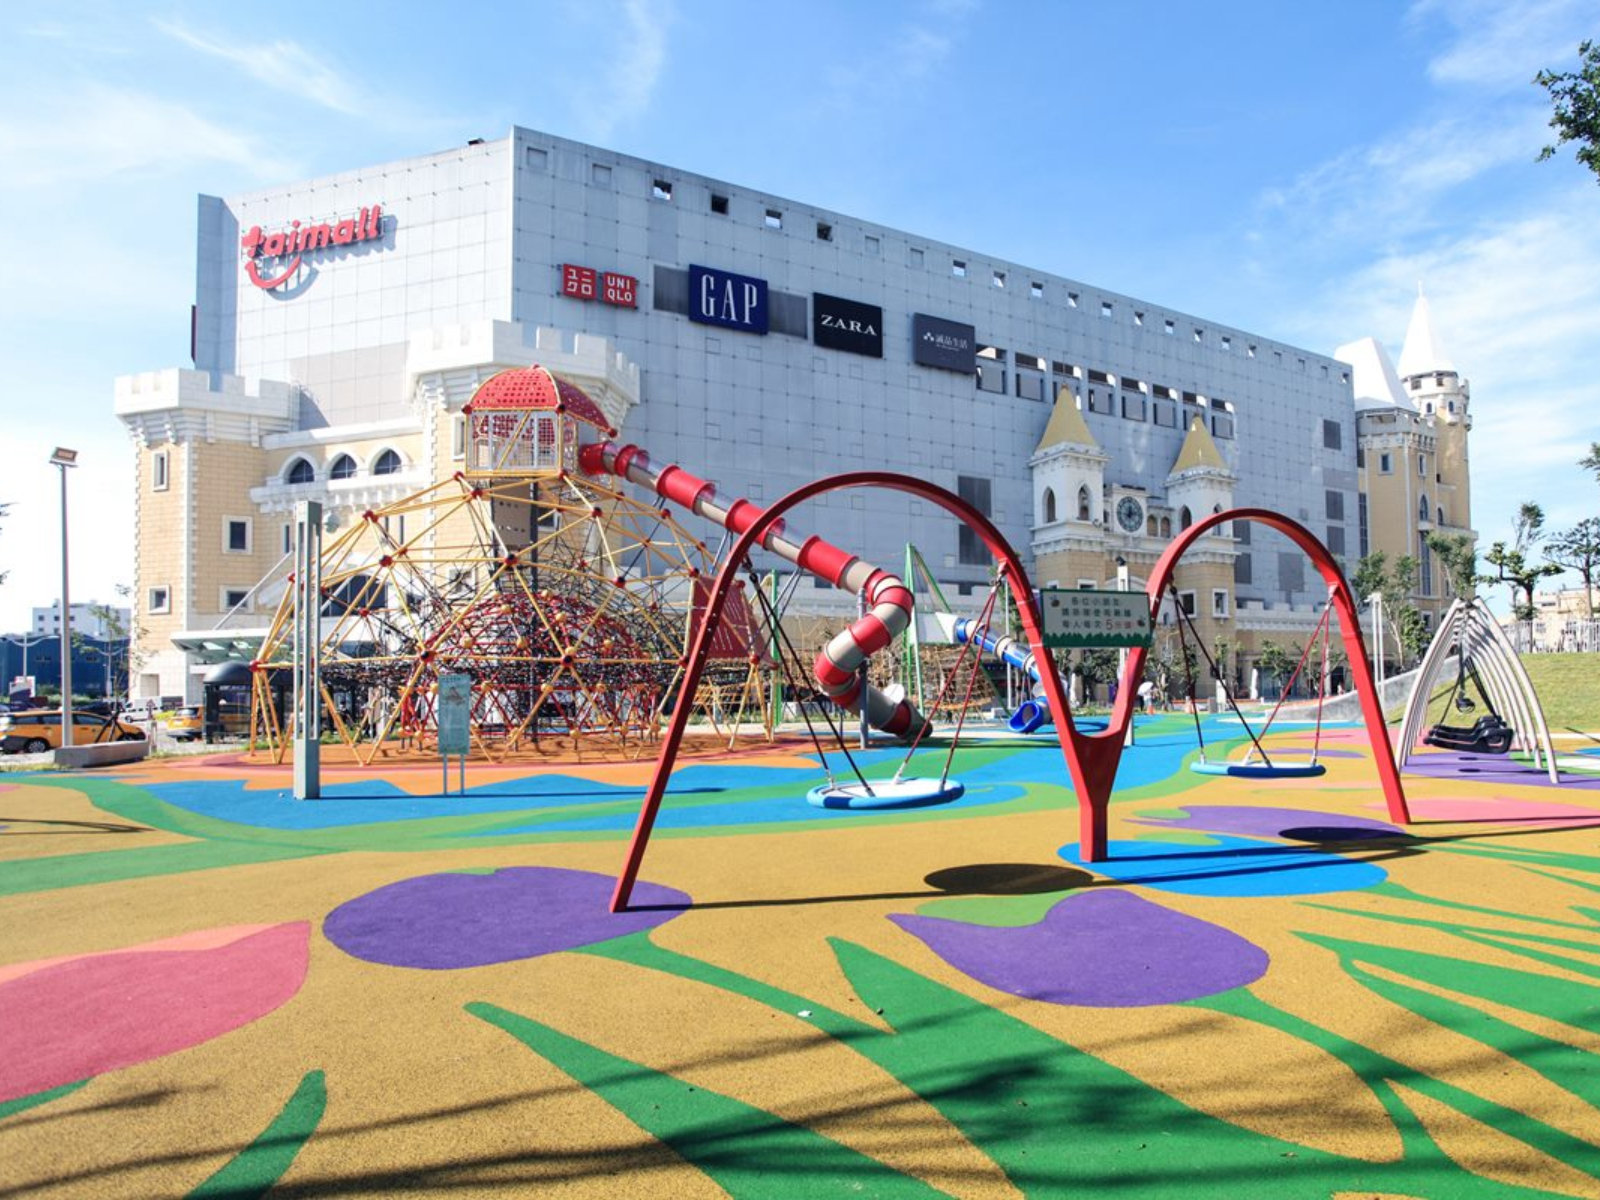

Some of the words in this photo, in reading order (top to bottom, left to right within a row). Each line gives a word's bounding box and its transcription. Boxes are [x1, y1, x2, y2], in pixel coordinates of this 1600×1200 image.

[241, 204, 381, 258] taimall
[607, 275, 631, 290] UNI
[607, 287, 632, 302] QLO
[701, 274, 757, 324] GAP
[821, 314, 877, 336] ZARA
